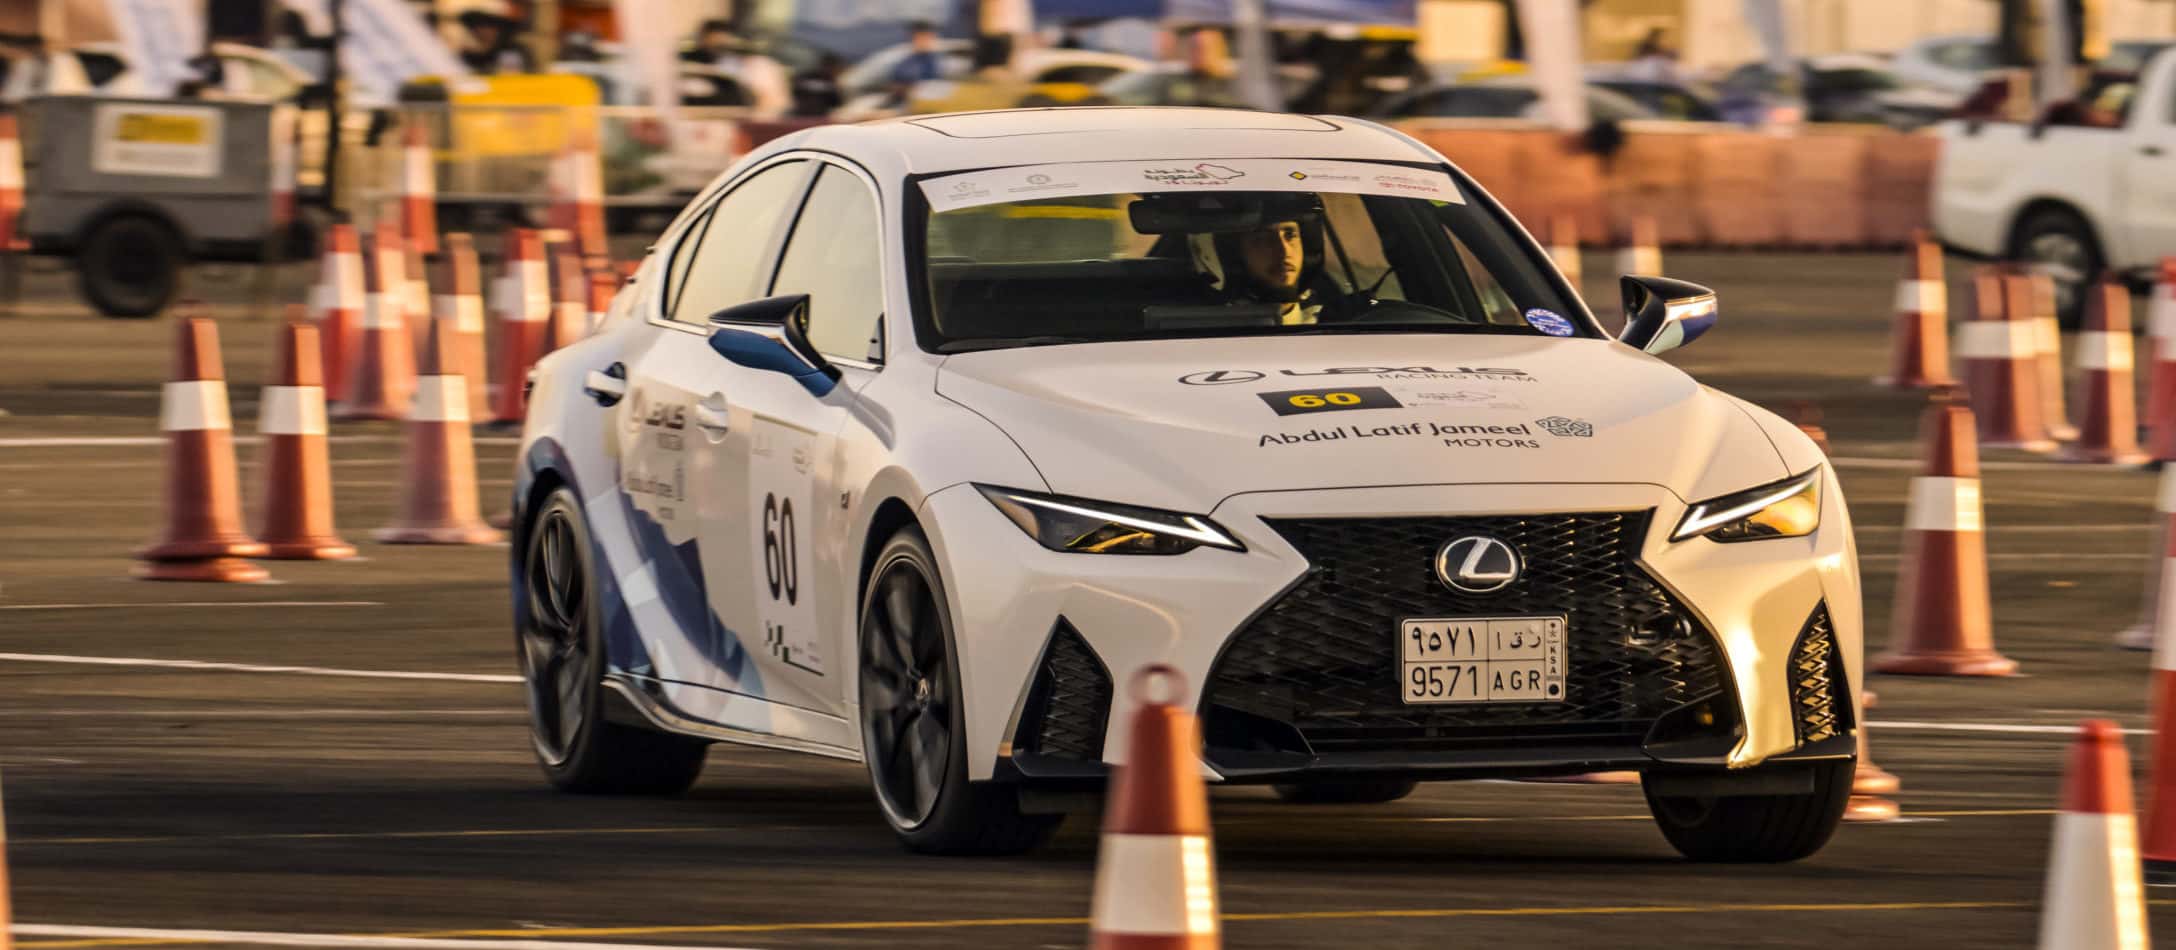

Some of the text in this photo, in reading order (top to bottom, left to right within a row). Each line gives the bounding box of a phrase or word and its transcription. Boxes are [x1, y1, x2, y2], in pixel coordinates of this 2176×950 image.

[1279, 366, 1529, 376] LEXUS
[1474, 374, 1538, 383] TEAM
[1289, 392, 1361, 408] 60
[1259, 422, 1531, 447] Abdul Latif Jameel
[1444, 438, 1540, 449] MOTORS
[763, 492, 797, 606] 60
[1412, 666, 1478, 697] 9571
